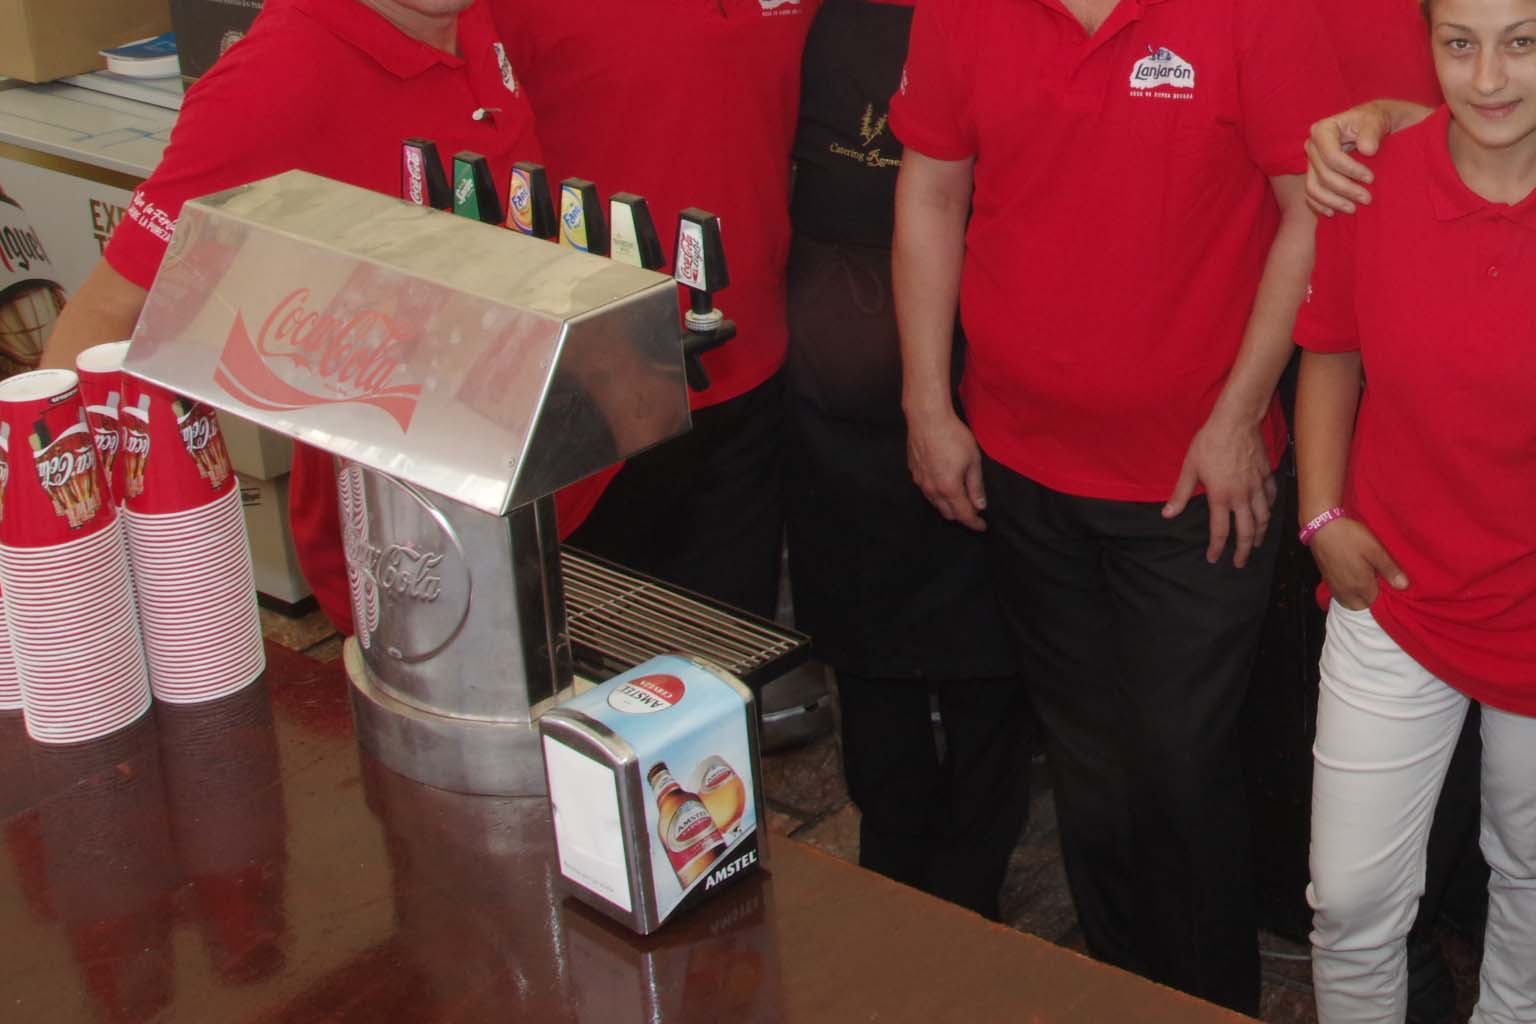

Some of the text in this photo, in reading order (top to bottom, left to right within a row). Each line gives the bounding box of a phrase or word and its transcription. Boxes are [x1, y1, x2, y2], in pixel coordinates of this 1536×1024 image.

[1135, 63, 1191, 81] Lanjarón
[257, 287, 417, 394] Coca-Cola
[619, 685, 665, 709] AMSTEL
[704, 849, 758, 891] AMSTEL
